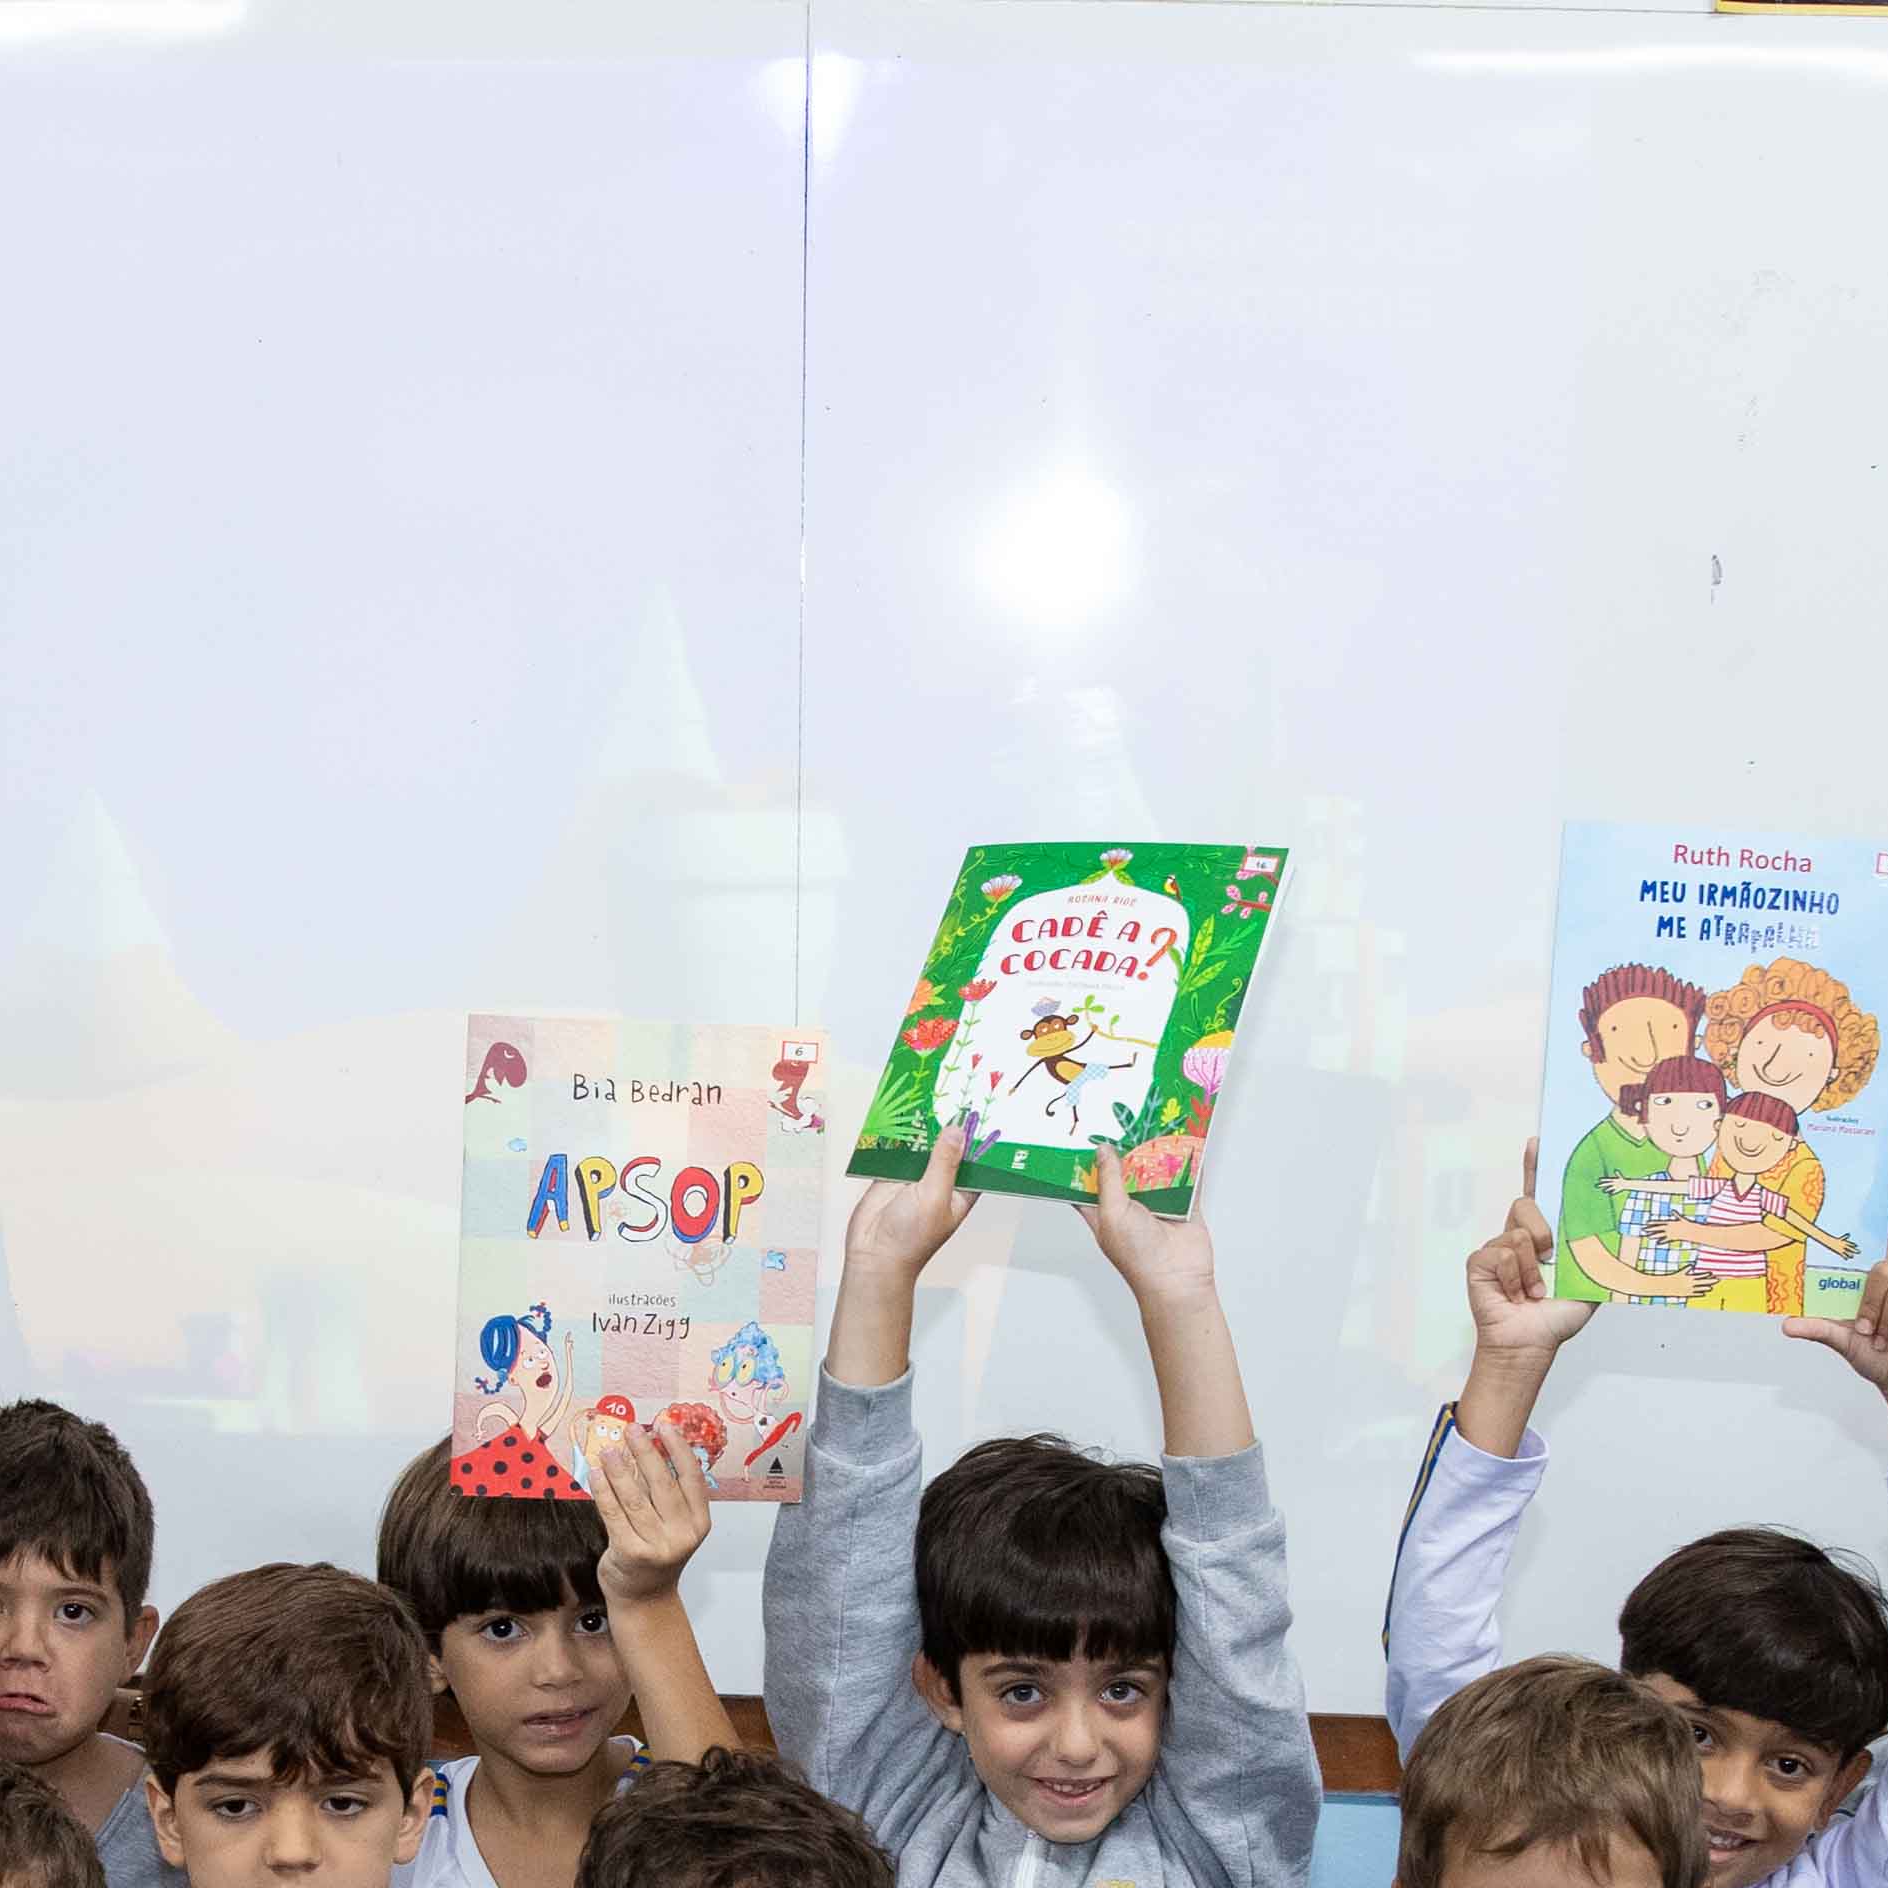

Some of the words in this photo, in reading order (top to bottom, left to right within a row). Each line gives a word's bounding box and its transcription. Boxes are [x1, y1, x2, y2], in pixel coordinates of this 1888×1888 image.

[1674, 845, 1730, 868] Ruth
[1739, 849, 1812, 873] Rocha
[1640, 880, 1685, 903] MEU
[1699, 882, 1839, 915] IRMÃOZINHO
[1012, 910, 1110, 944] CADÊ
[1657, 916, 1686, 939] ME
[573, 1074, 616, 1103] Bia
[631, 1080, 722, 1105] Bedran
[527, 1154, 764, 1244] APSOP
[1818, 1275, 1860, 1291] global
[593, 1312, 637, 1334] Ivan
[643, 1312, 690, 1340] Zigg
